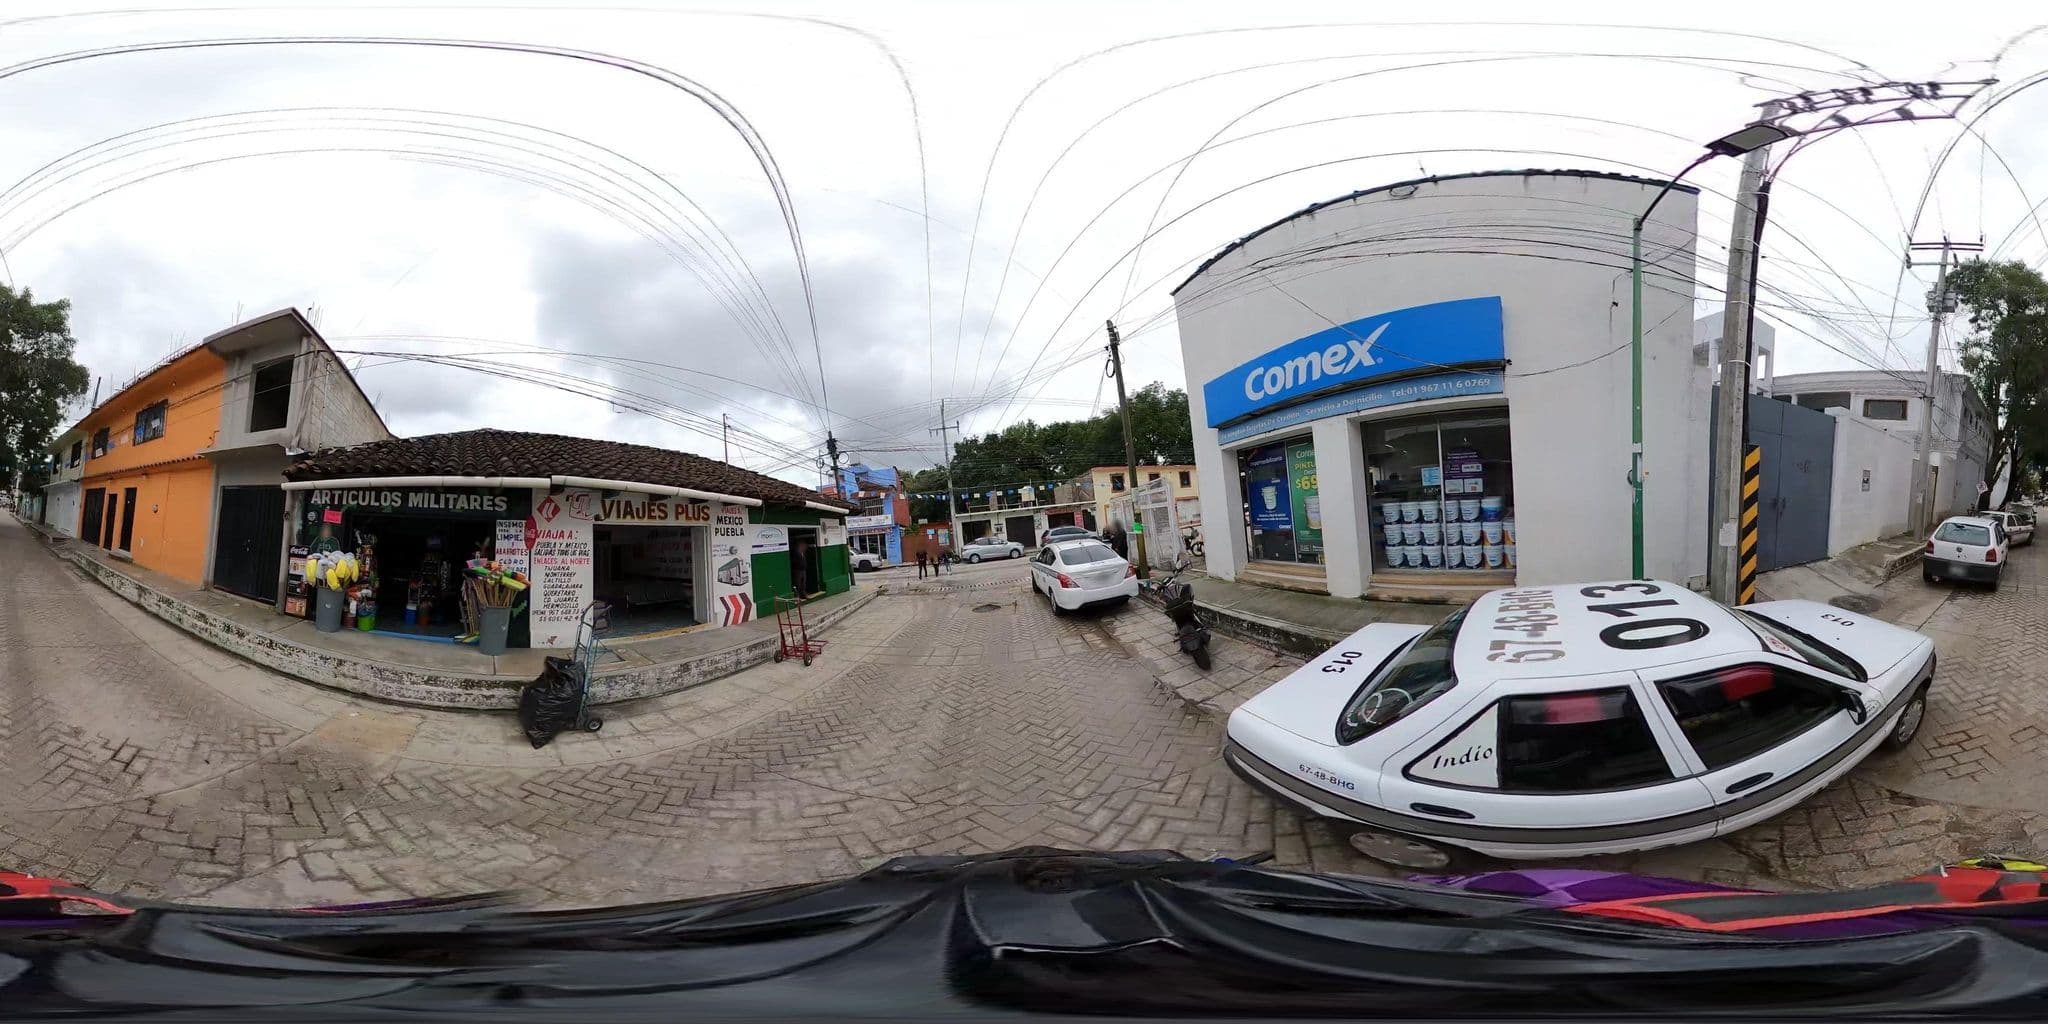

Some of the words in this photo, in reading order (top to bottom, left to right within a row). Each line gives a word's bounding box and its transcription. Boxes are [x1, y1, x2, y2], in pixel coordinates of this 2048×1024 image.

[1245, 321, 1391, 401] Comex
[1305, 402, 1335, 416] Servicio
[1343, 393, 1383, 407] Domicilio
[1421, 383, 1438, 394] 967
[1456, 380, 1463, 389] 6
[310, 489, 402, 508] ARTICULOS
[408, 491, 509, 513] MILITARES
[600, 499, 668, 521] VIAJES
[674, 503, 711, 522] PLUS
[714, 527, 745, 537] PUEBLA
[716, 515, 744, 526] MEXICO
[535, 541, 557, 549] PUEBLA
[536, 529, 565, 540] VIAJA
[570, 557, 591, 566] NORTE
[1579, 583, 1710, 650] 013
[1820, 613, 1855, 627] 013
[1321, 651, 1363, 674] 013
[1432, 744, 1494, 770] Indio
[1299, 763, 1355, 791] 67-48-BHG
